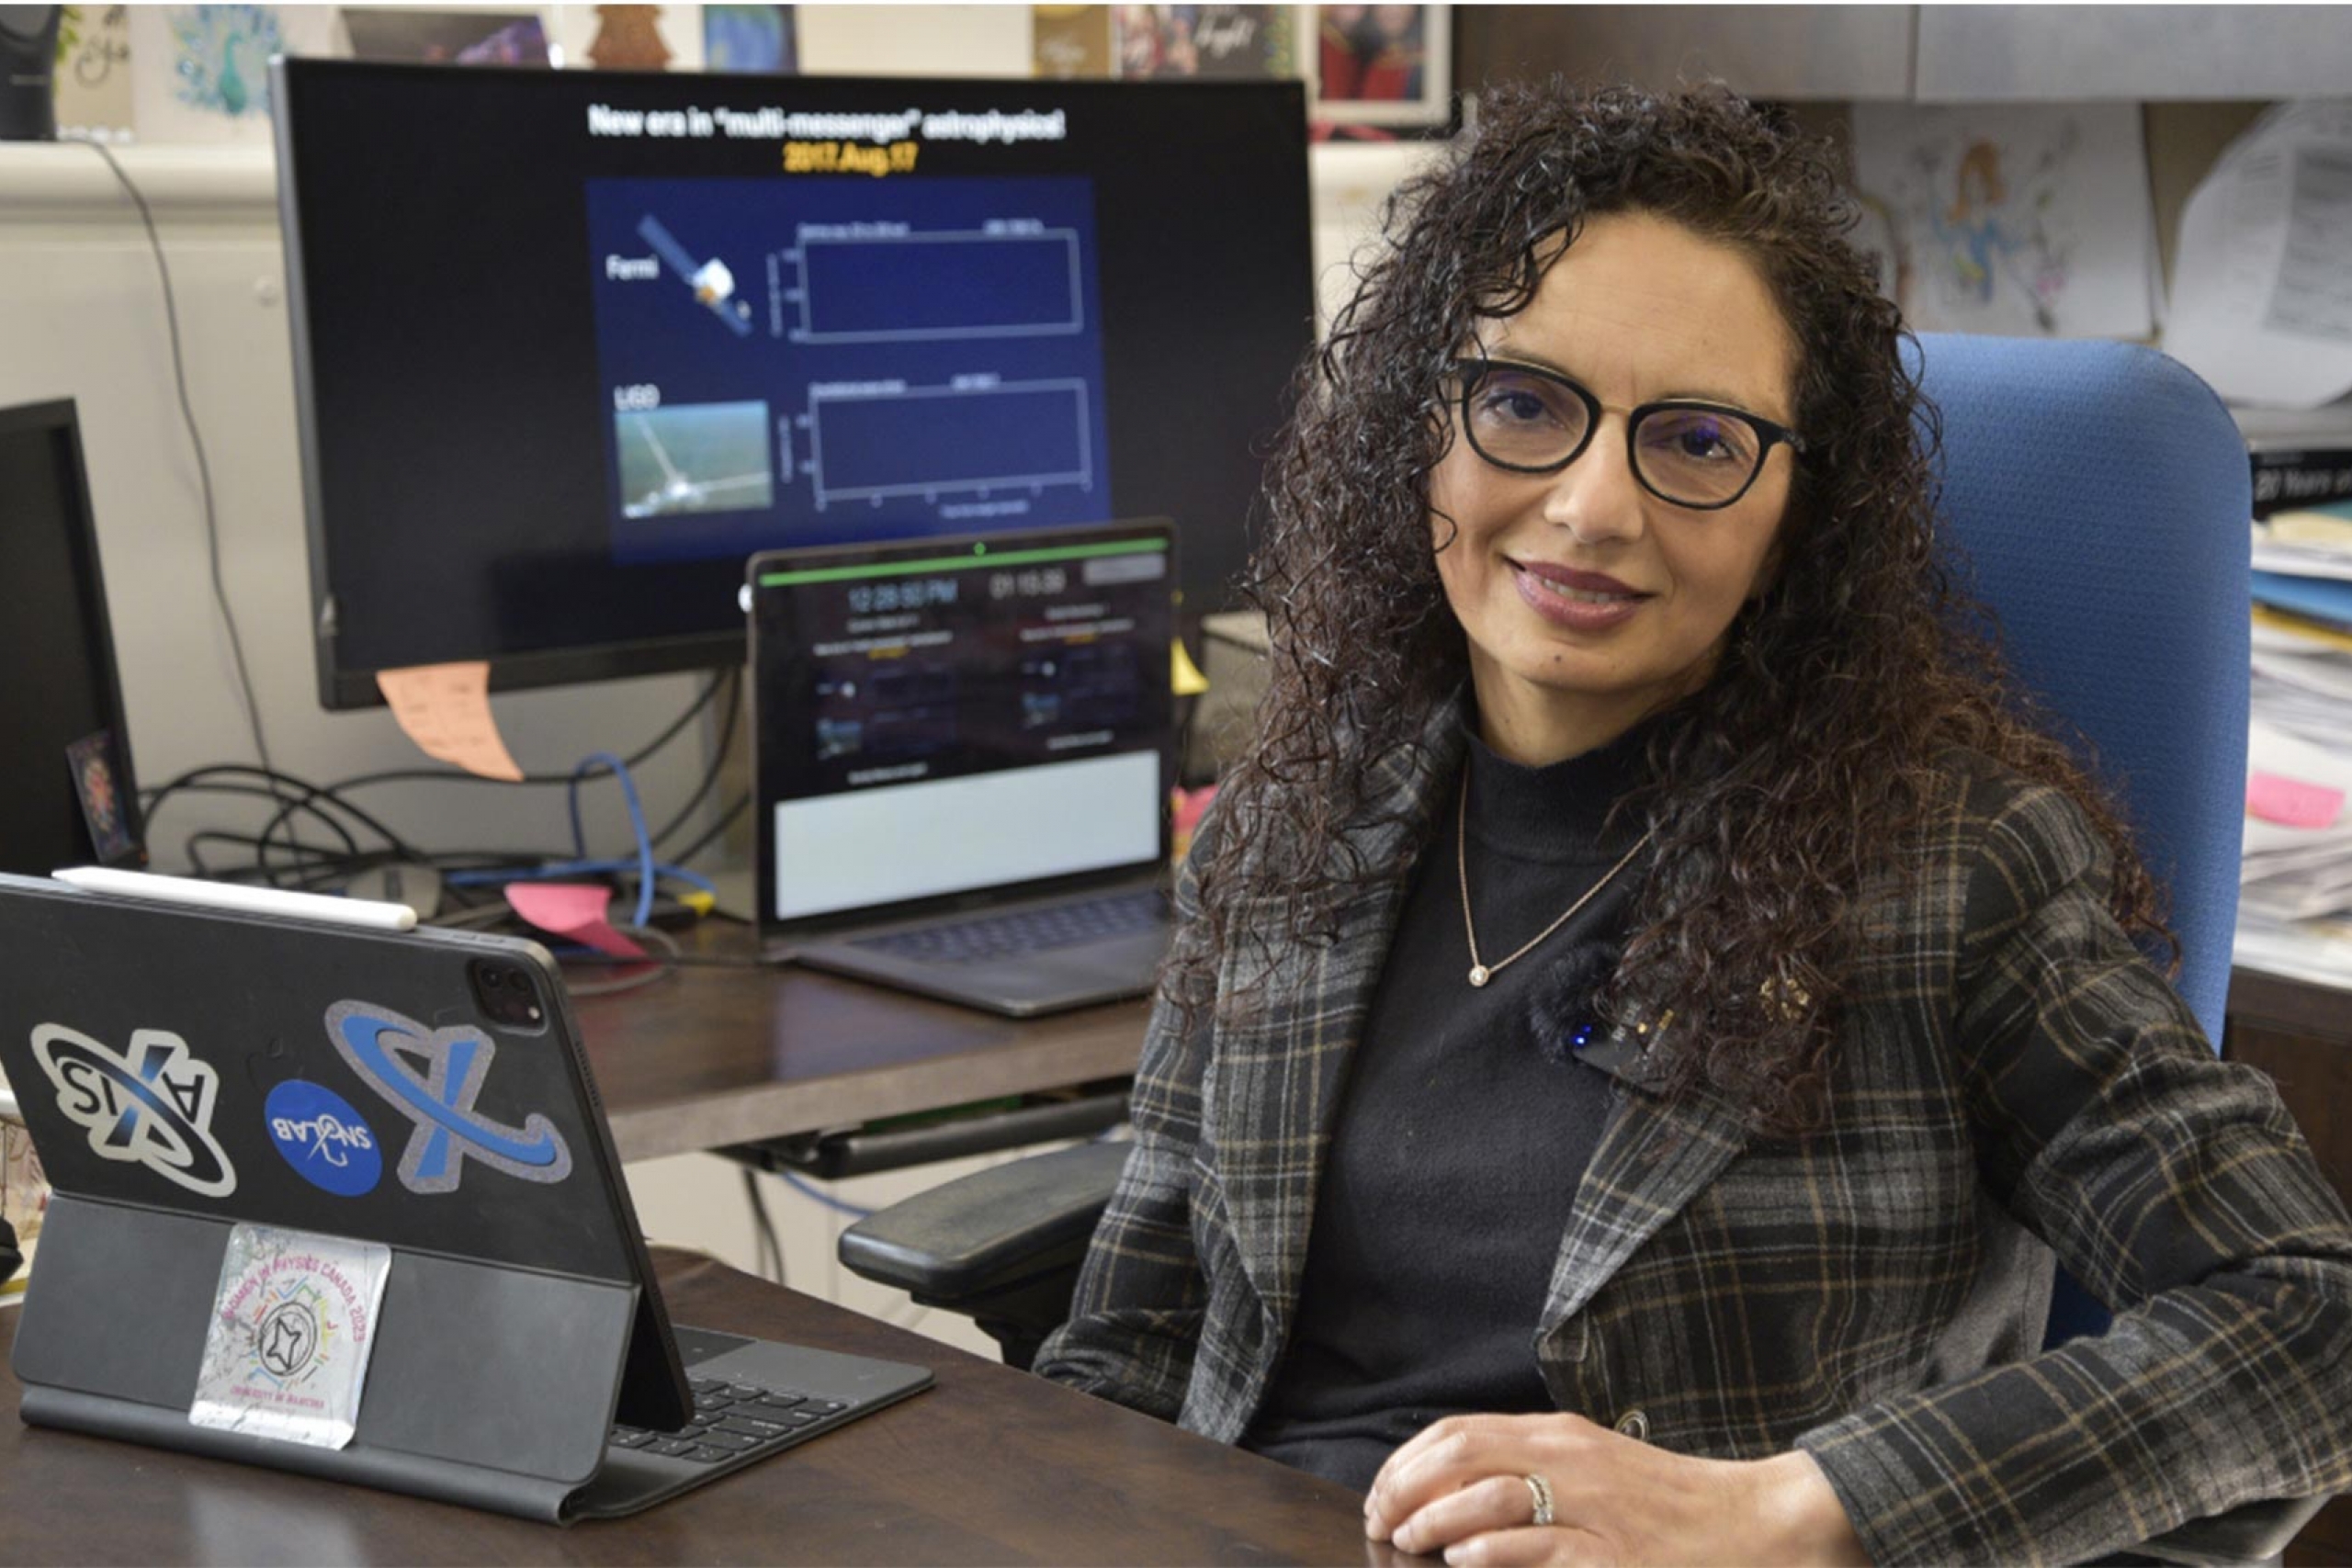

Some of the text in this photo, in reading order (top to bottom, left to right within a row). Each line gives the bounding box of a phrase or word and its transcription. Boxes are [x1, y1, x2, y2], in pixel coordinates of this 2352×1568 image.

[587, 103, 644, 137] New
[645, 109, 687, 137] era
[687, 105, 714, 137] in
